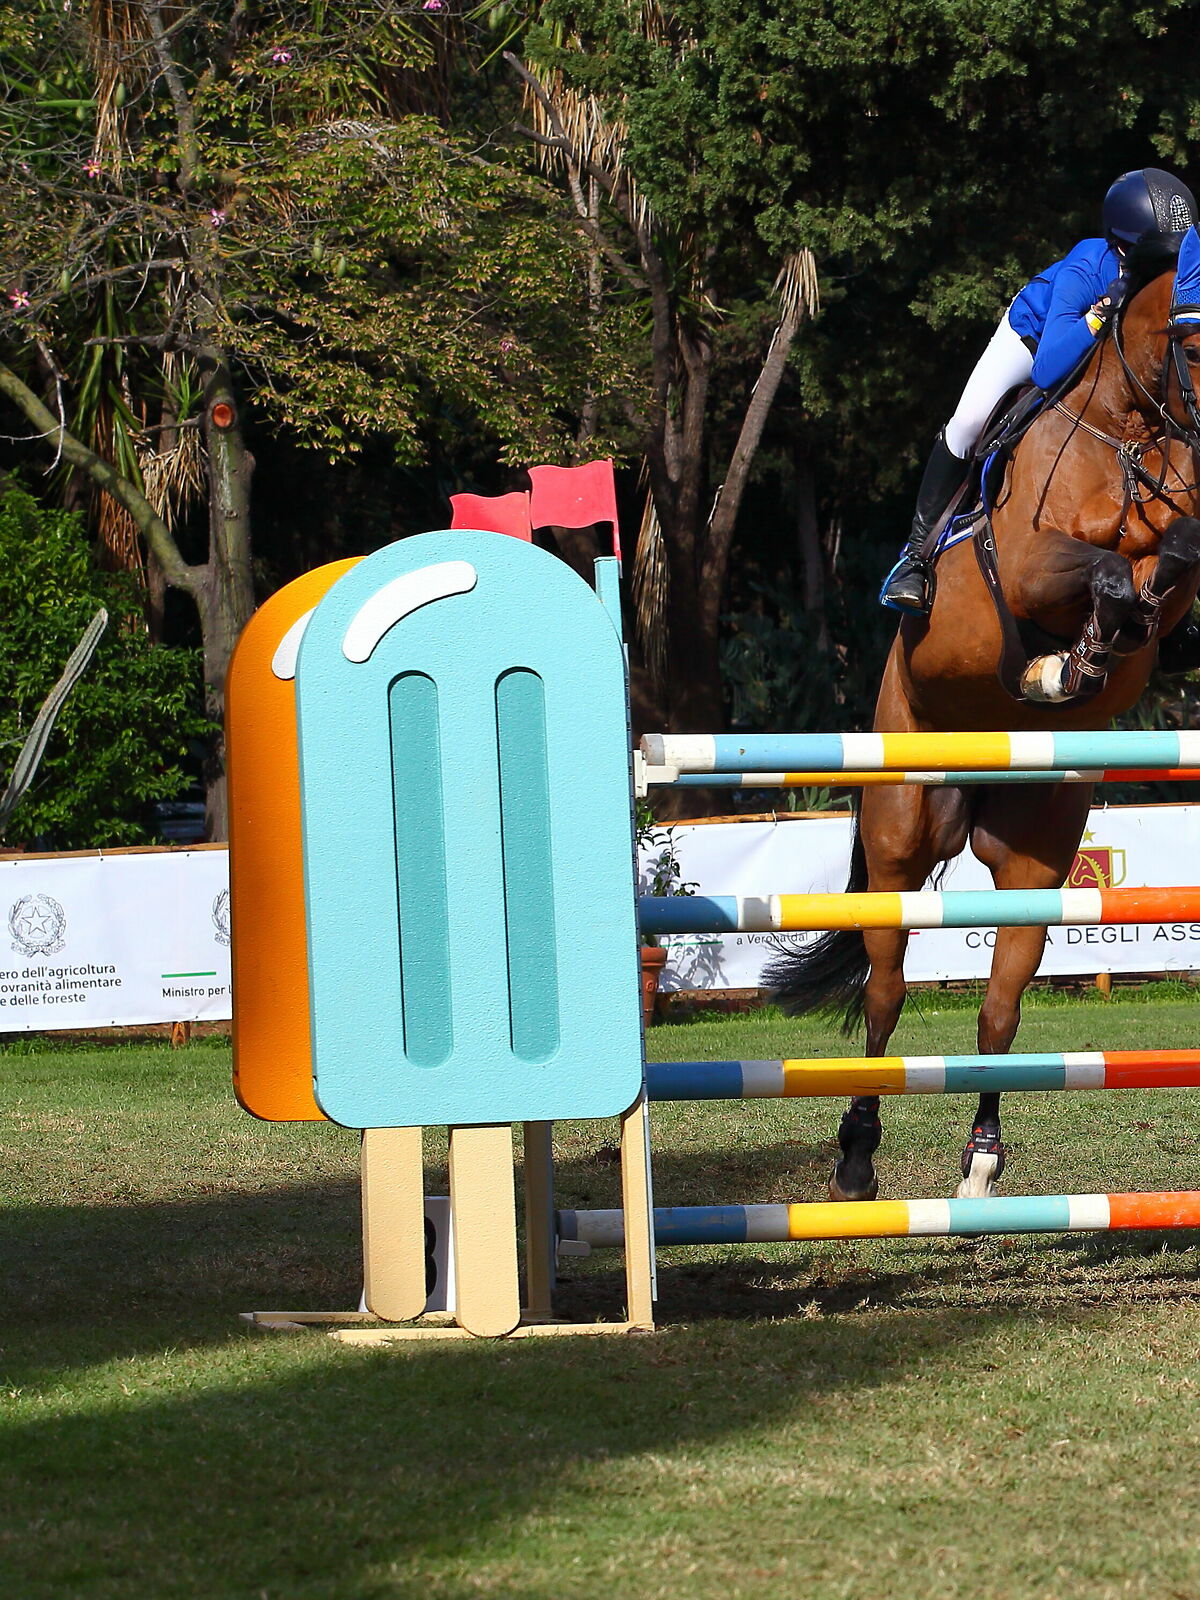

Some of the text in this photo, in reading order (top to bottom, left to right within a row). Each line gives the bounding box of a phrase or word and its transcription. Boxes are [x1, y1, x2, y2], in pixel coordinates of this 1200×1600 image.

[736, 936, 743, 945] a
[965, 930, 1054, 948] COA
[1067, 926, 1139, 944] DEGLI
[55, 978, 122, 990] alimentare
[162, 986, 205, 998] Ministro
[208, 987, 225, 998] per
[10, 995, 40, 1006] delle
[43, 993, 86, 1004] foreste
